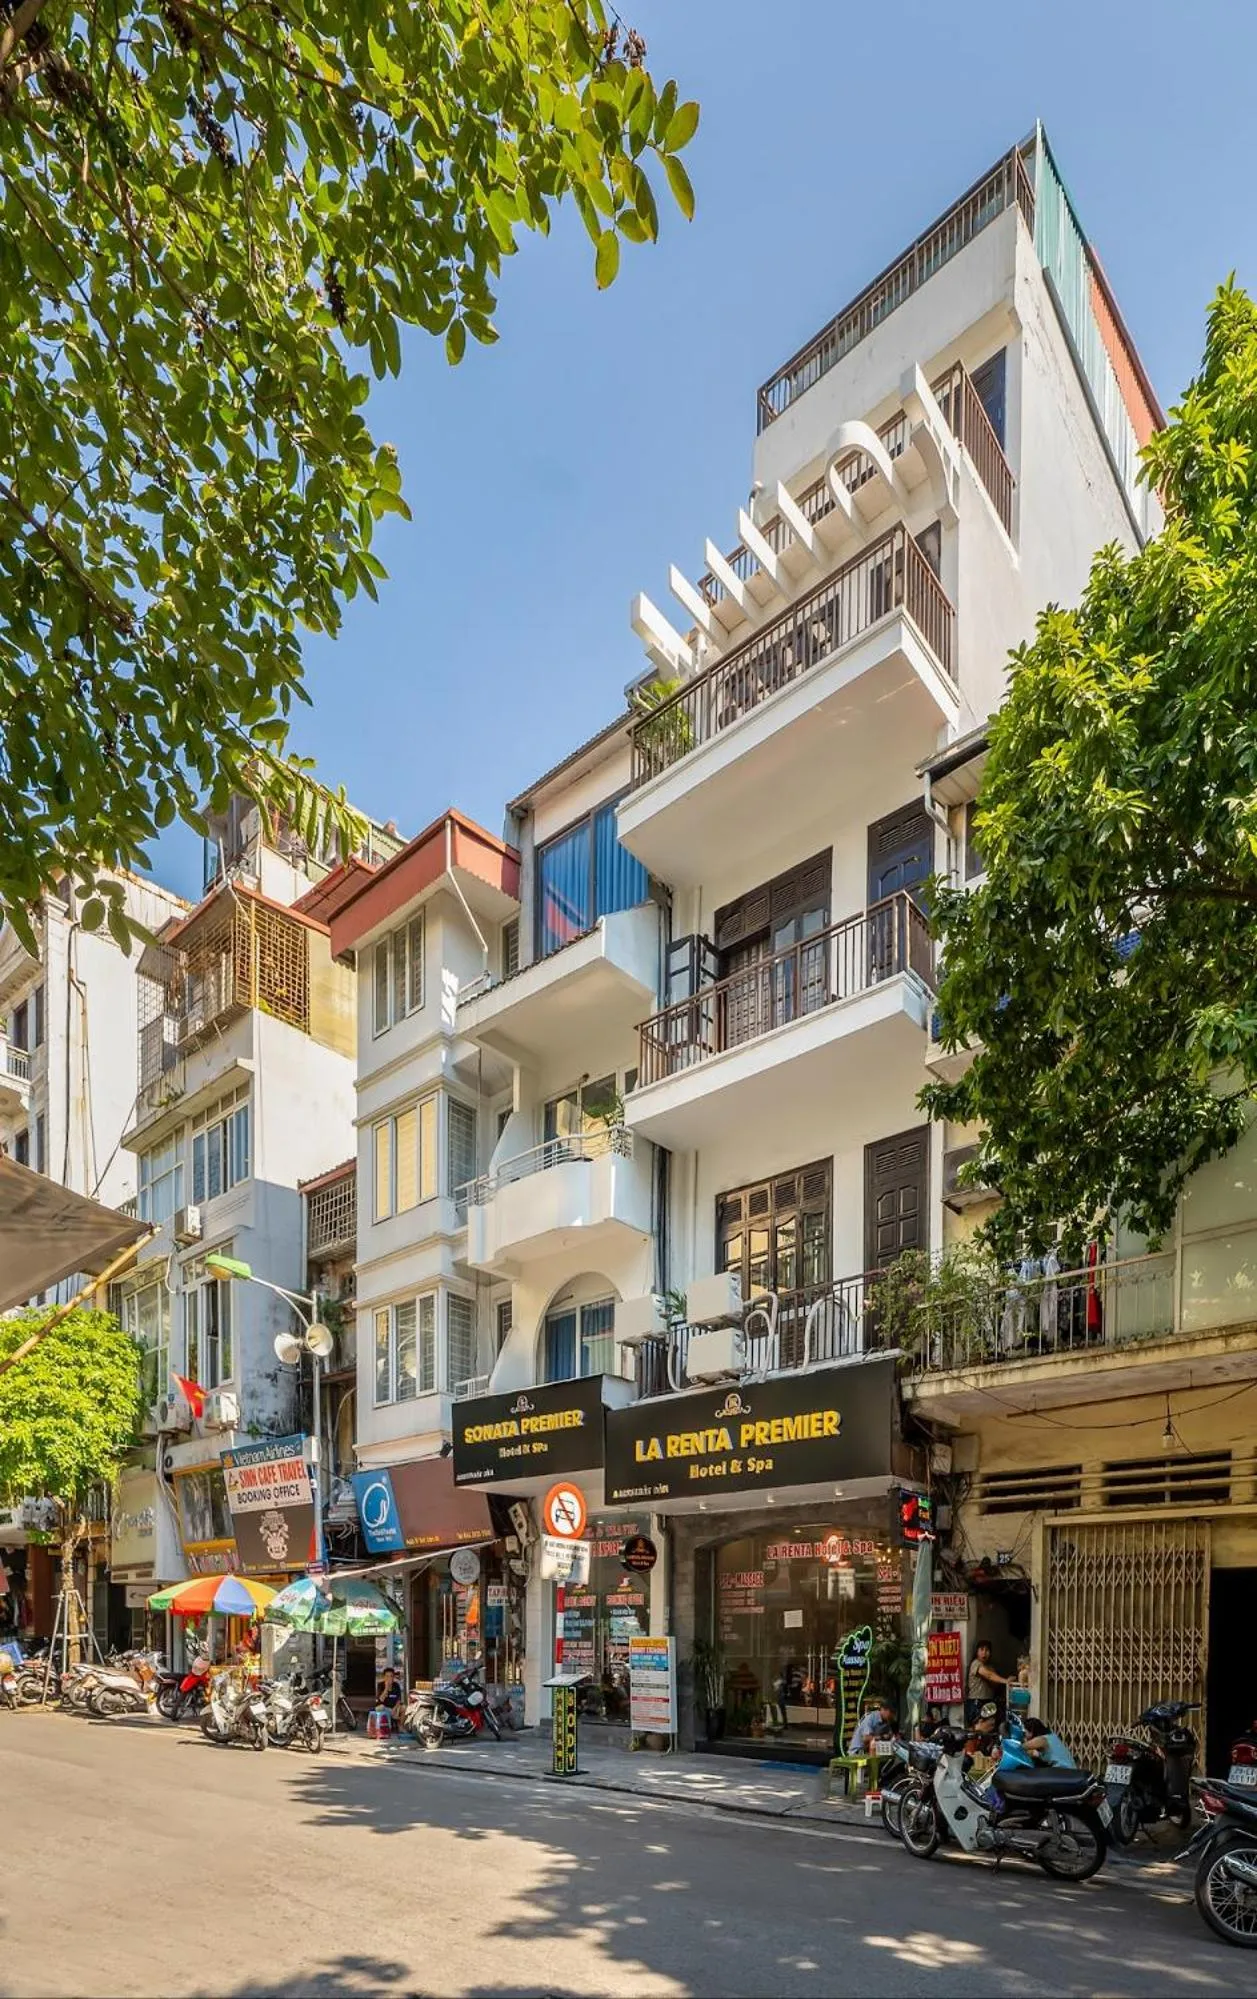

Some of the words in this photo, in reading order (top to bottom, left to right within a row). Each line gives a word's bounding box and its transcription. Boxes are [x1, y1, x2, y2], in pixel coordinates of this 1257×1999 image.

[464, 1420, 520, 1444] SONATA
[521, 1410, 584, 1434] PREMIER
[635, 1437, 664, 1462] LA
[666, 1427, 733, 1458] RENTA
[740, 1410, 842, 1448] PREMIER
[278, 1458, 307, 1482] TRAVEL
[689, 1461, 727, 1479] Hotel
[730, 1459, 742, 1473] &
[747, 1457, 773, 1474] Spa
[237, 1488, 272, 1504] BOOKING
[273, 1484, 300, 1500] OFFICE
[852, 1538, 875, 1555] Spa
